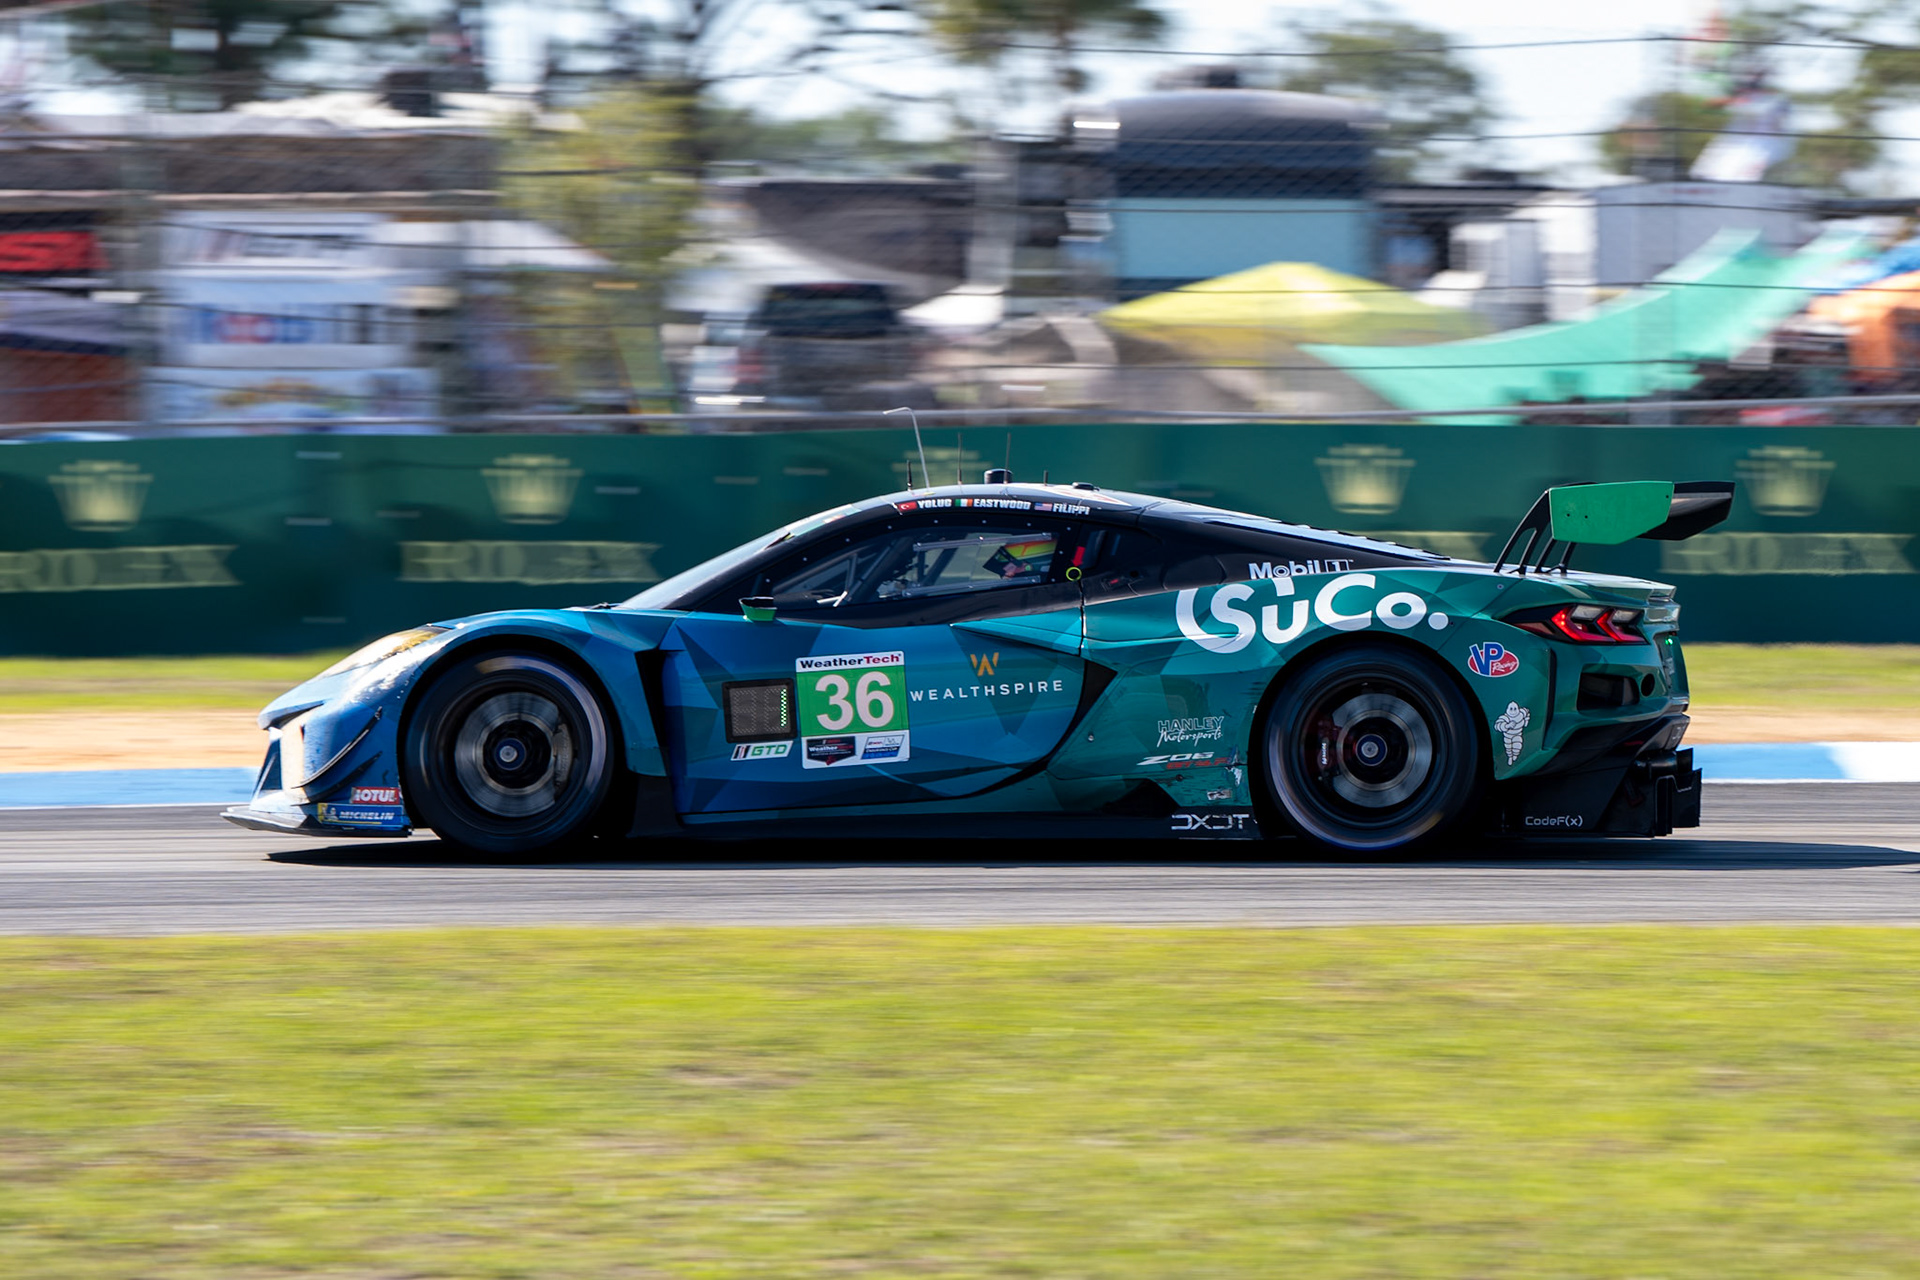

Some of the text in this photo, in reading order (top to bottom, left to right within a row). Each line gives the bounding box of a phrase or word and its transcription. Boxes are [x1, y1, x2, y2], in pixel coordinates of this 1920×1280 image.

[973, 499, 1031, 510] EASTWOOD
[1052, 503, 1090, 515] FILIPPI
[1248, 559, 1320, 580] Mobil
[800, 654, 900, 669] WeatherTech
[1469, 641, 1504, 677] VP
[910, 680, 1063, 702] WEALTHSPIRE
[815, 671, 894, 731] 36
[1158, 716, 1224, 732] HANLEY
[1157, 727, 1223, 747] Motorsports
[751, 744, 787, 756] GTD
[1136, 752, 1214, 766] Z06
[339, 811, 395, 820] MICHELIN
[1525, 815, 1583, 826] CodeF(x)
